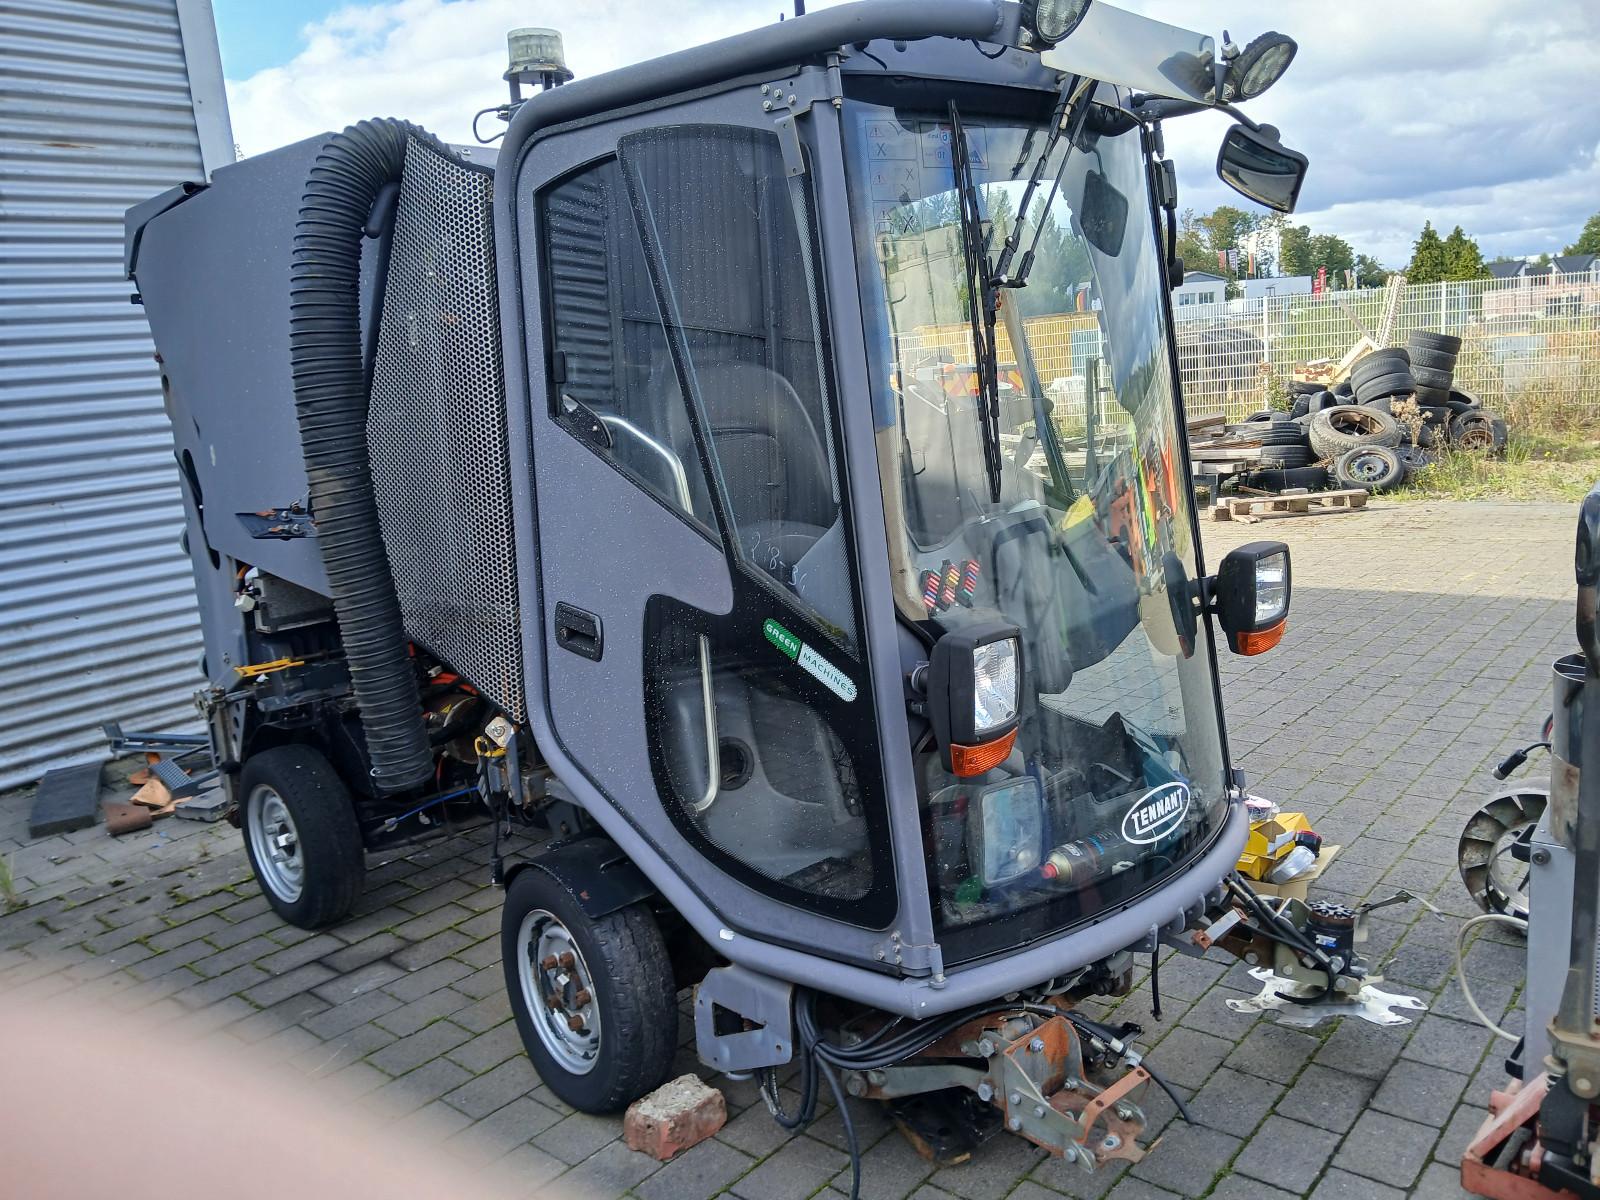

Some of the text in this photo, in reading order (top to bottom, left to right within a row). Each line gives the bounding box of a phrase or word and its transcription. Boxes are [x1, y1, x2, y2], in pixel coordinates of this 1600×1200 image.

[765, 623, 854, 696] GREEN MACHINES
[1131, 787, 1183, 834] TENNANT
